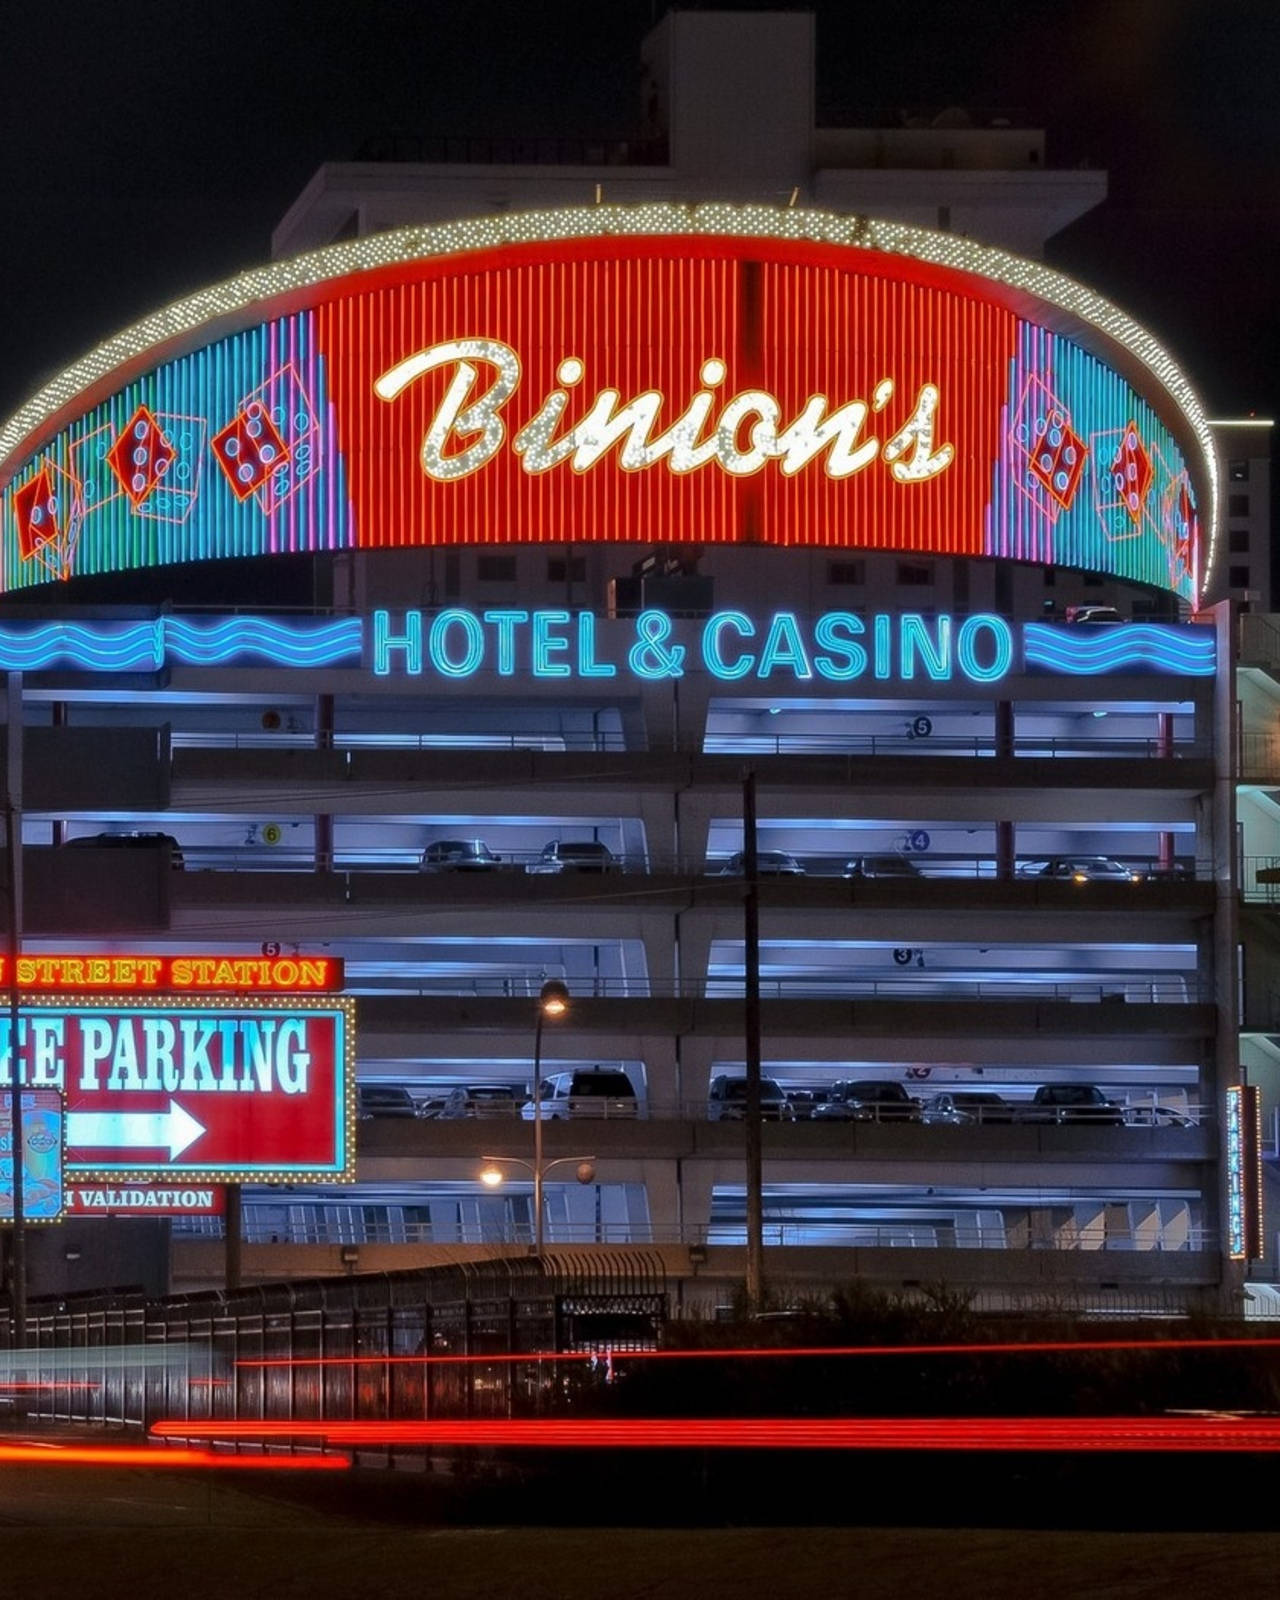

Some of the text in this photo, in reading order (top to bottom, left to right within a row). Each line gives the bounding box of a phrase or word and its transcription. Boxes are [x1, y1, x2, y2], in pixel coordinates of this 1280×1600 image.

[373, 337, 955, 482] Binion's
[373, 609, 1014, 682] HOTEL & CASINO
[16, 958, 162, 985] STREET
[171, 958, 328, 986] STATION
[79, 1017, 311, 1094] PARKING
[79, 1190, 214, 1207] VALIDATION
